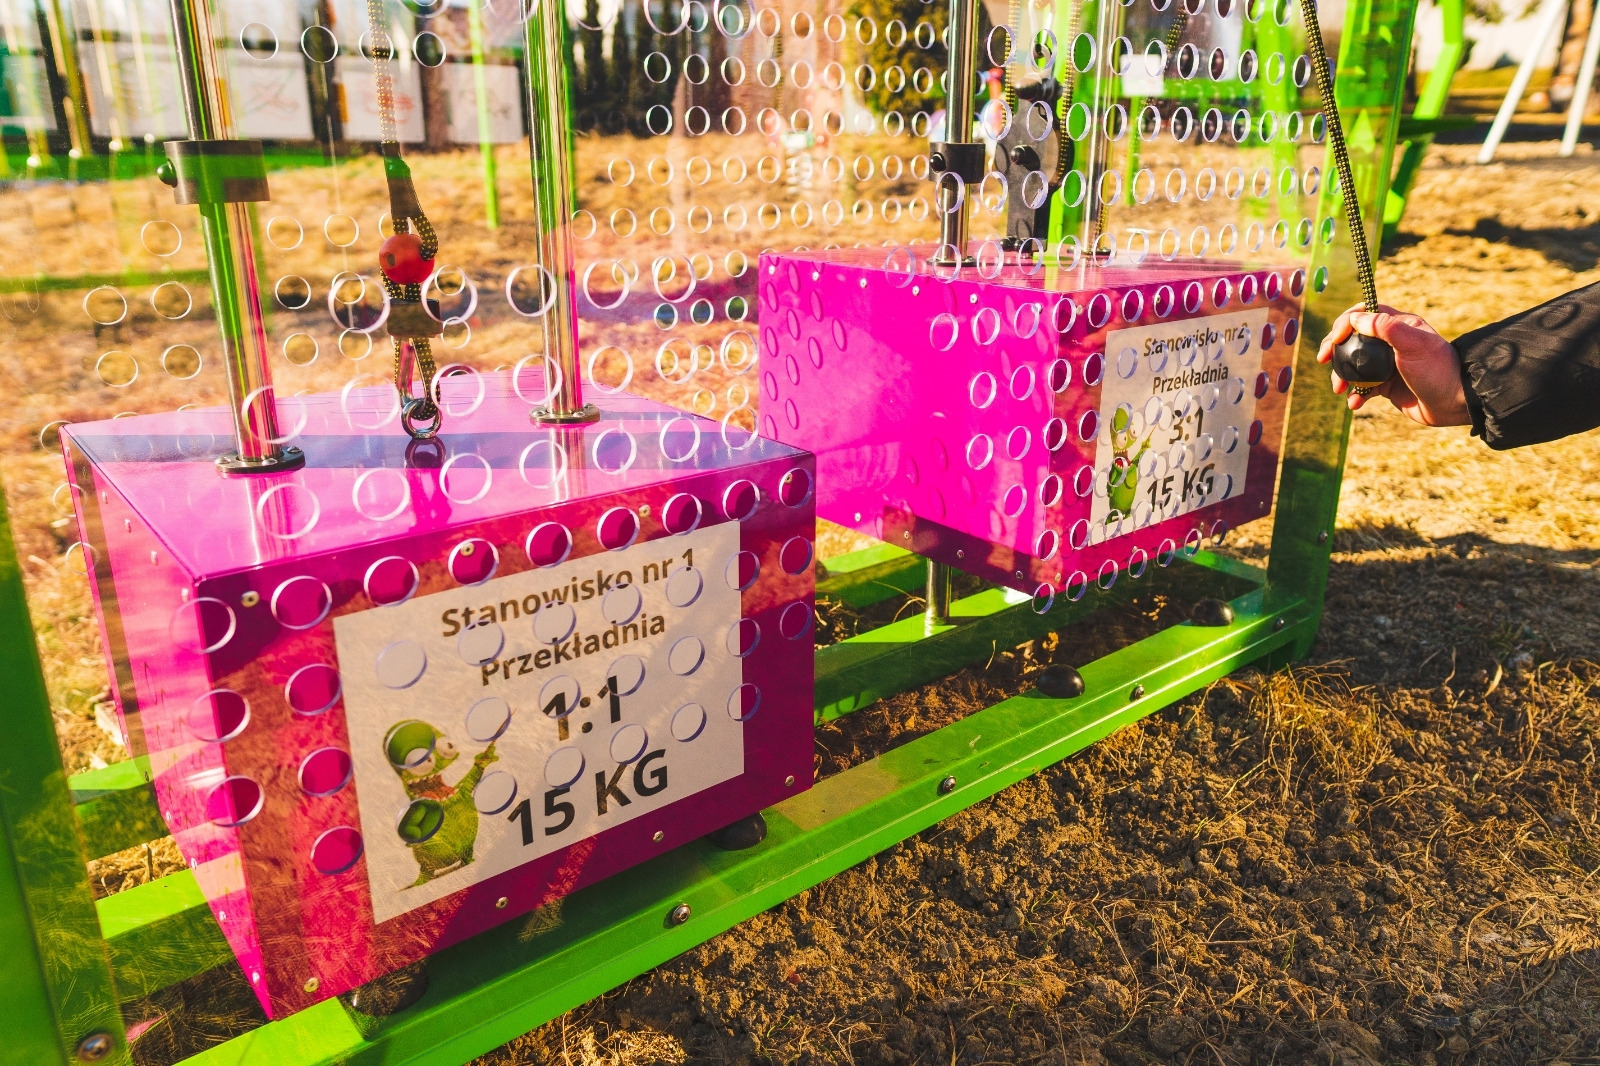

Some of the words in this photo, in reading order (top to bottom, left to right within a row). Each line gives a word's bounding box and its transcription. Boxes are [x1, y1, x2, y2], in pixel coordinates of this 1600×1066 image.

[1143, 327, 1219, 357] Stanowisko
[1152, 363, 1229, 394] Przekładnia
[1169, 405, 1204, 445] 3:1
[1147, 475, 1174, 512] 15
[1182, 463, 1215, 503] KG
[441, 569, 633, 638] Stanowisko
[642, 557, 673, 585] nr
[681, 548, 694, 574] 1
[479, 612, 666, 686] Przekładnia
[542, 675, 622, 741] 1:1
[507, 785, 576, 848] 15
[595, 748, 670, 817] KG
